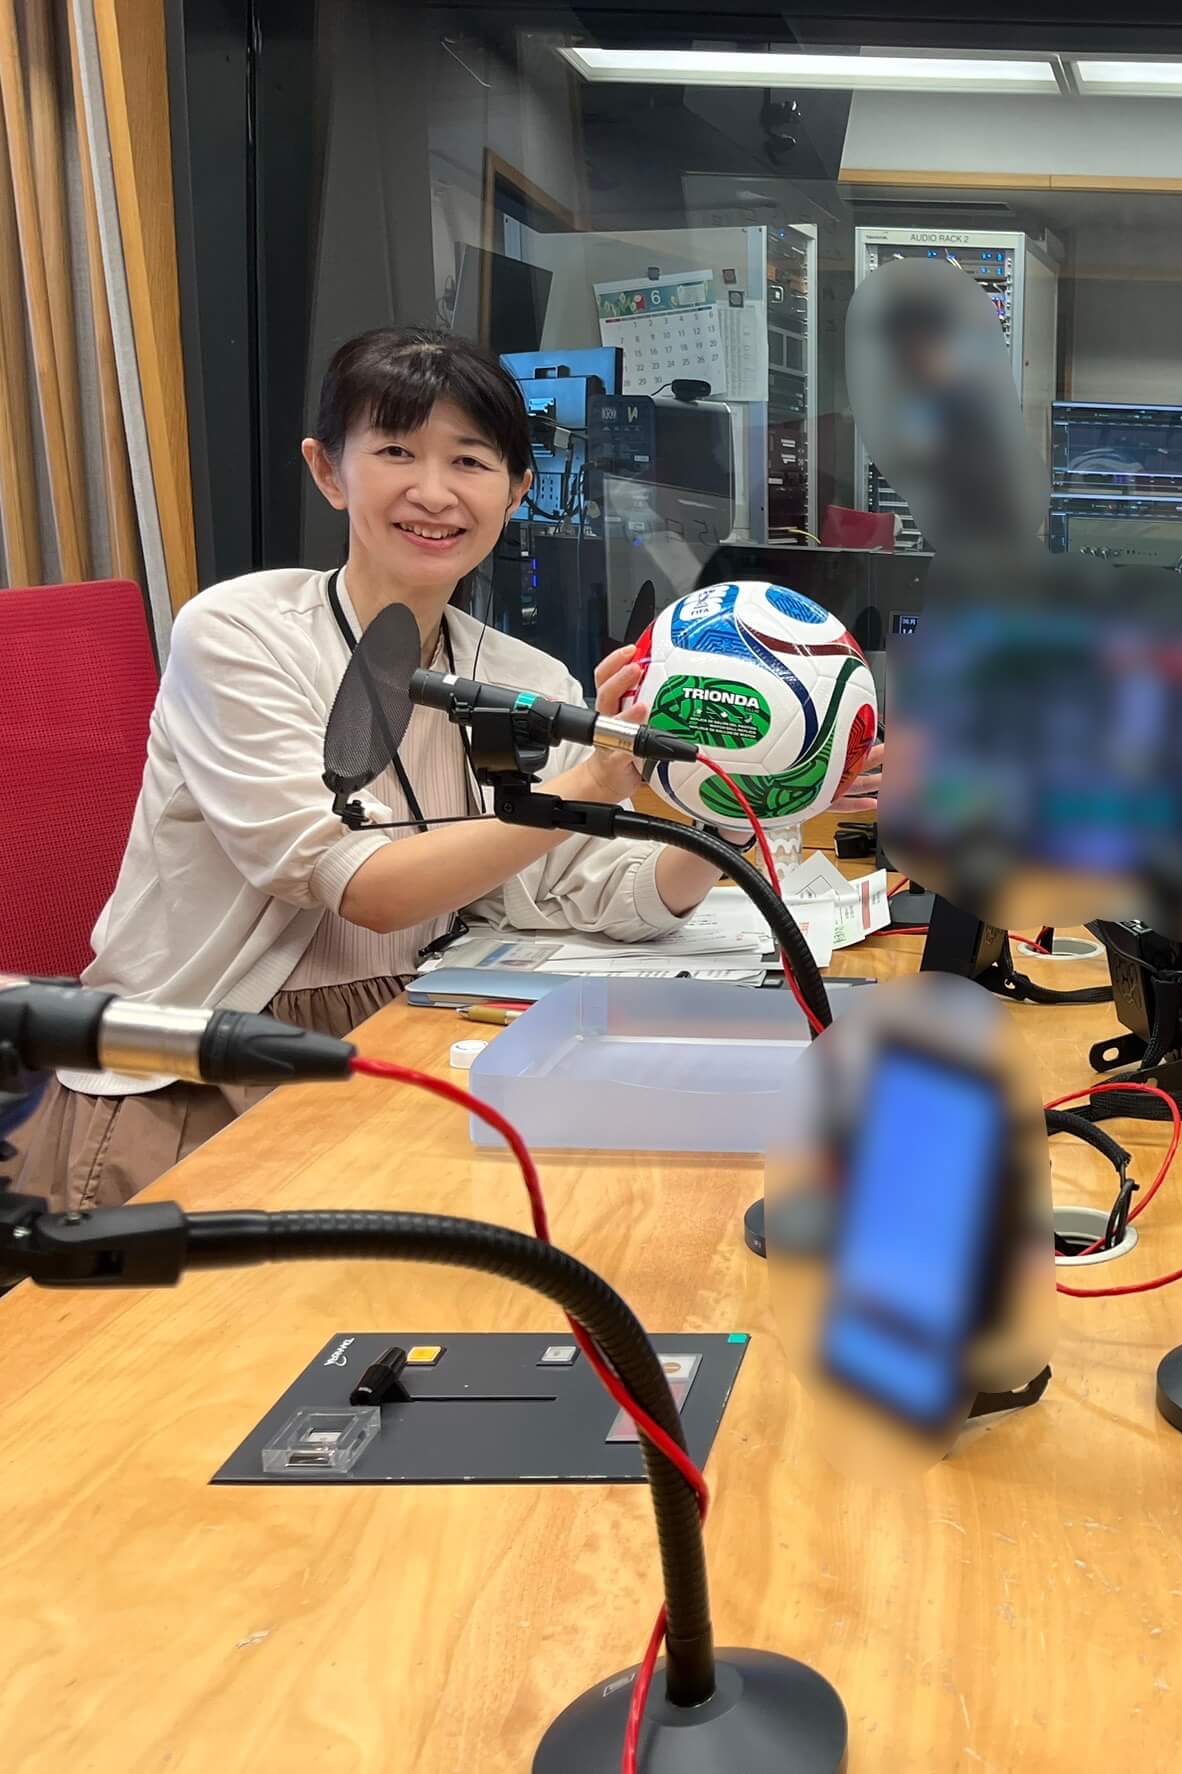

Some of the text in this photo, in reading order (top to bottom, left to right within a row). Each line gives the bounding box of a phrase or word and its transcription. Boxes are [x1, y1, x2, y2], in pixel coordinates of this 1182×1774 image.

[909, 233, 969, 243] AUDIO RACK 2
[650, 289, 661, 305] 6
[690, 608, 710, 617] FIFA
[682, 687, 760, 709] TRIONDA
